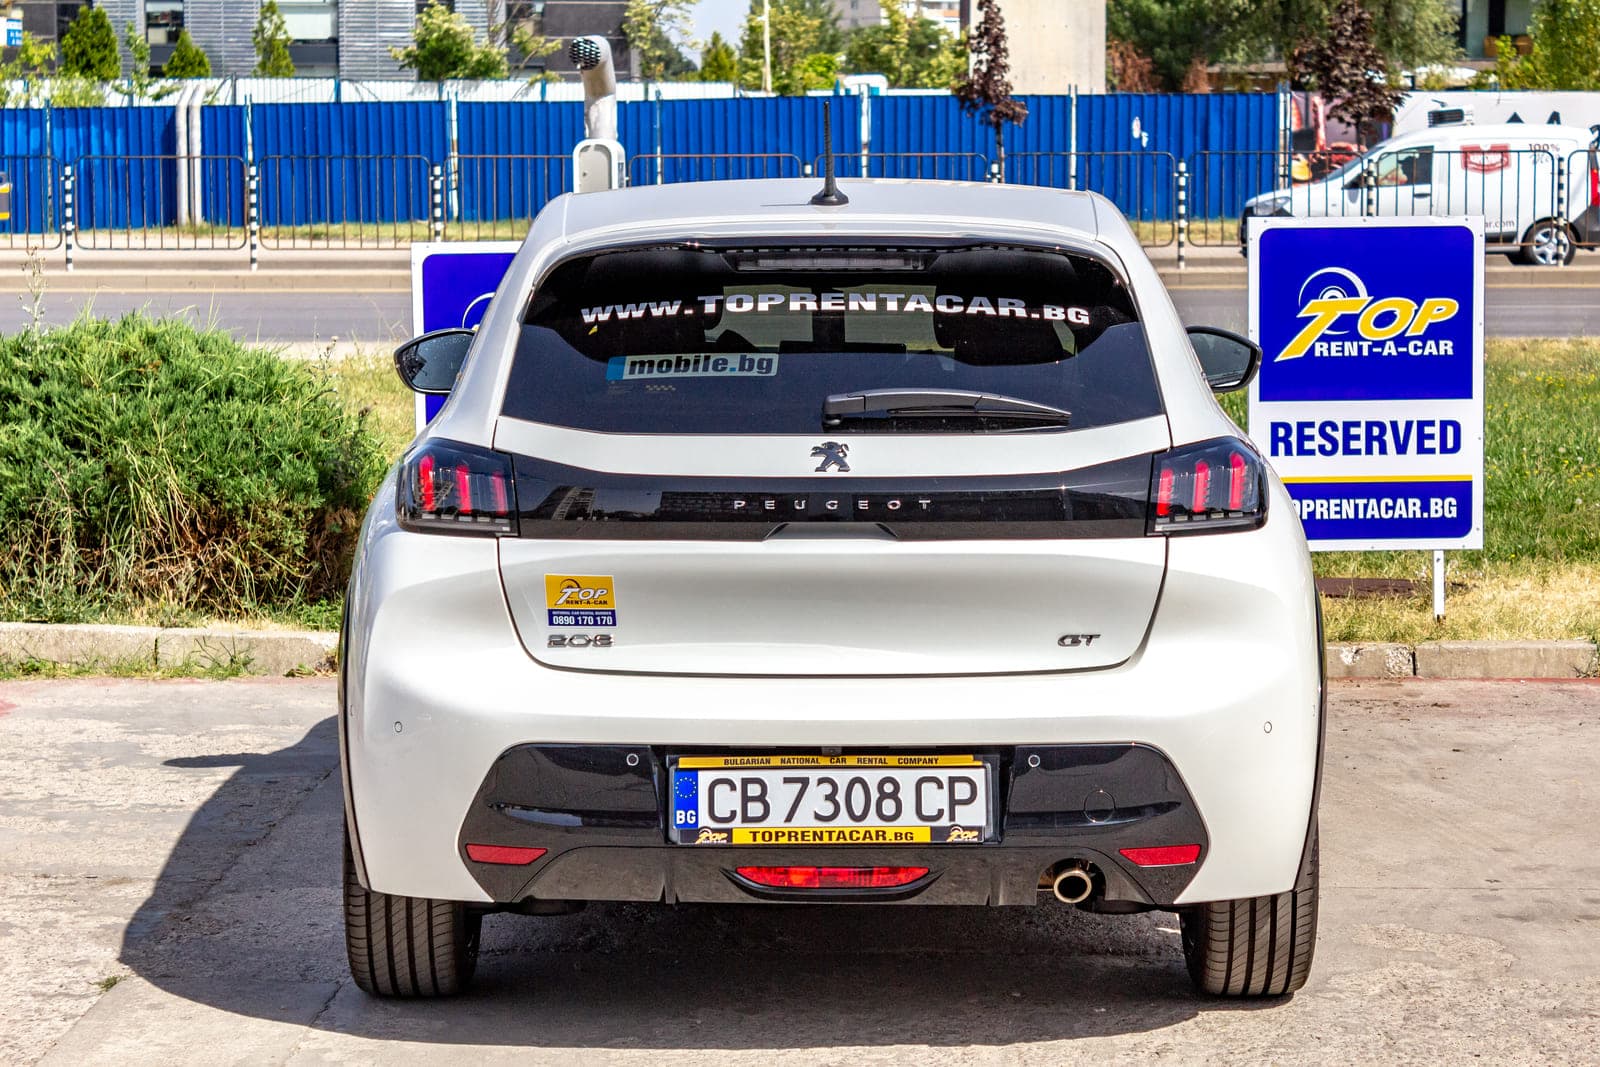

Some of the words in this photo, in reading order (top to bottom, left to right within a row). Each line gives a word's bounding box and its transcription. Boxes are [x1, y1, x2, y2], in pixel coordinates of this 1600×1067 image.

[581, 292, 1090, 325] WWW.TOPRENTACAR.BG
[1274, 296, 1459, 362] TOP
[1314, 340, 1454, 357] RENT-A-CAR
[628, 354, 774, 376] mobile.bg
[1270, 420, 1462, 457] RESERVED
[733, 500, 931, 510] PEUGEOT
[555, 587, 608, 606] TOP
[553, 616, 575, 625] 0890
[577, 616, 594, 625] 170
[596, 616, 613, 625] 170
[547, 634, 613, 648] 208
[1057, 634, 1101, 647] GT
[723, 758, 771, 766] BULGARIAN
[780, 757, 821, 765] NATIONAL
[708, 777, 771, 823] CB
[782, 776, 902, 823] 7308
[915, 776, 978, 823] CP
[676, 810, 697, 824] BG
[749, 830, 914, 842] TOPRENTACAR.BG
